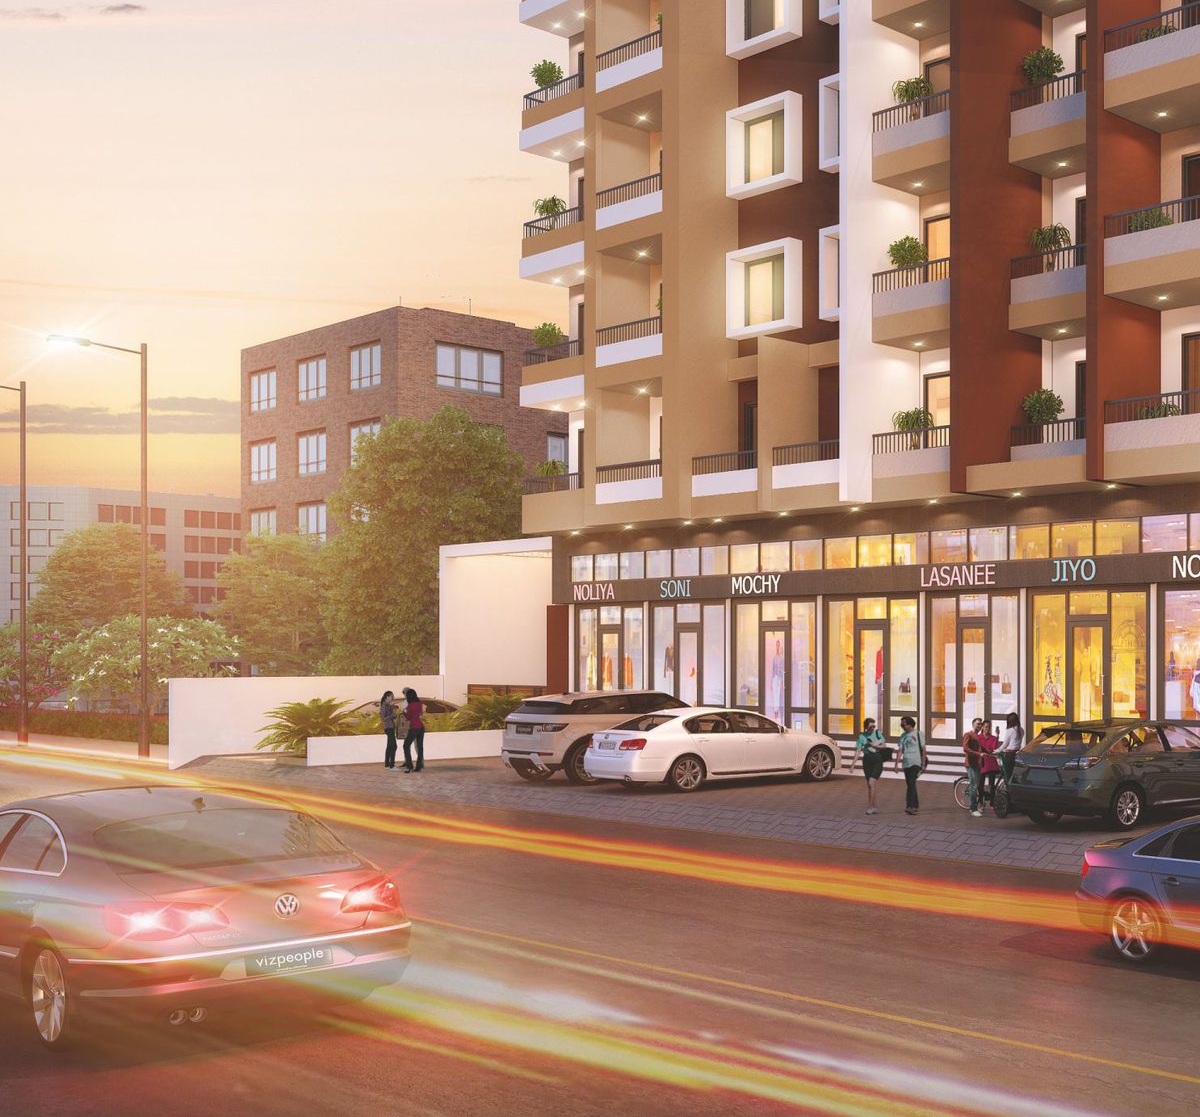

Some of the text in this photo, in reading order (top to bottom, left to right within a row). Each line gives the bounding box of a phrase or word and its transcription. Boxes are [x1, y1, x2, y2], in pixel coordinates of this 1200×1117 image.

[920, 564, 996, 588] LASANEE
[1051, 558, 1096, 582] JIYO
[573, 583, 615, 601] NOLIYA
[660, 579, 691, 598] SONI
[731, 574, 781, 595] MOCHY
[255, 948, 324, 968] vizpeople
